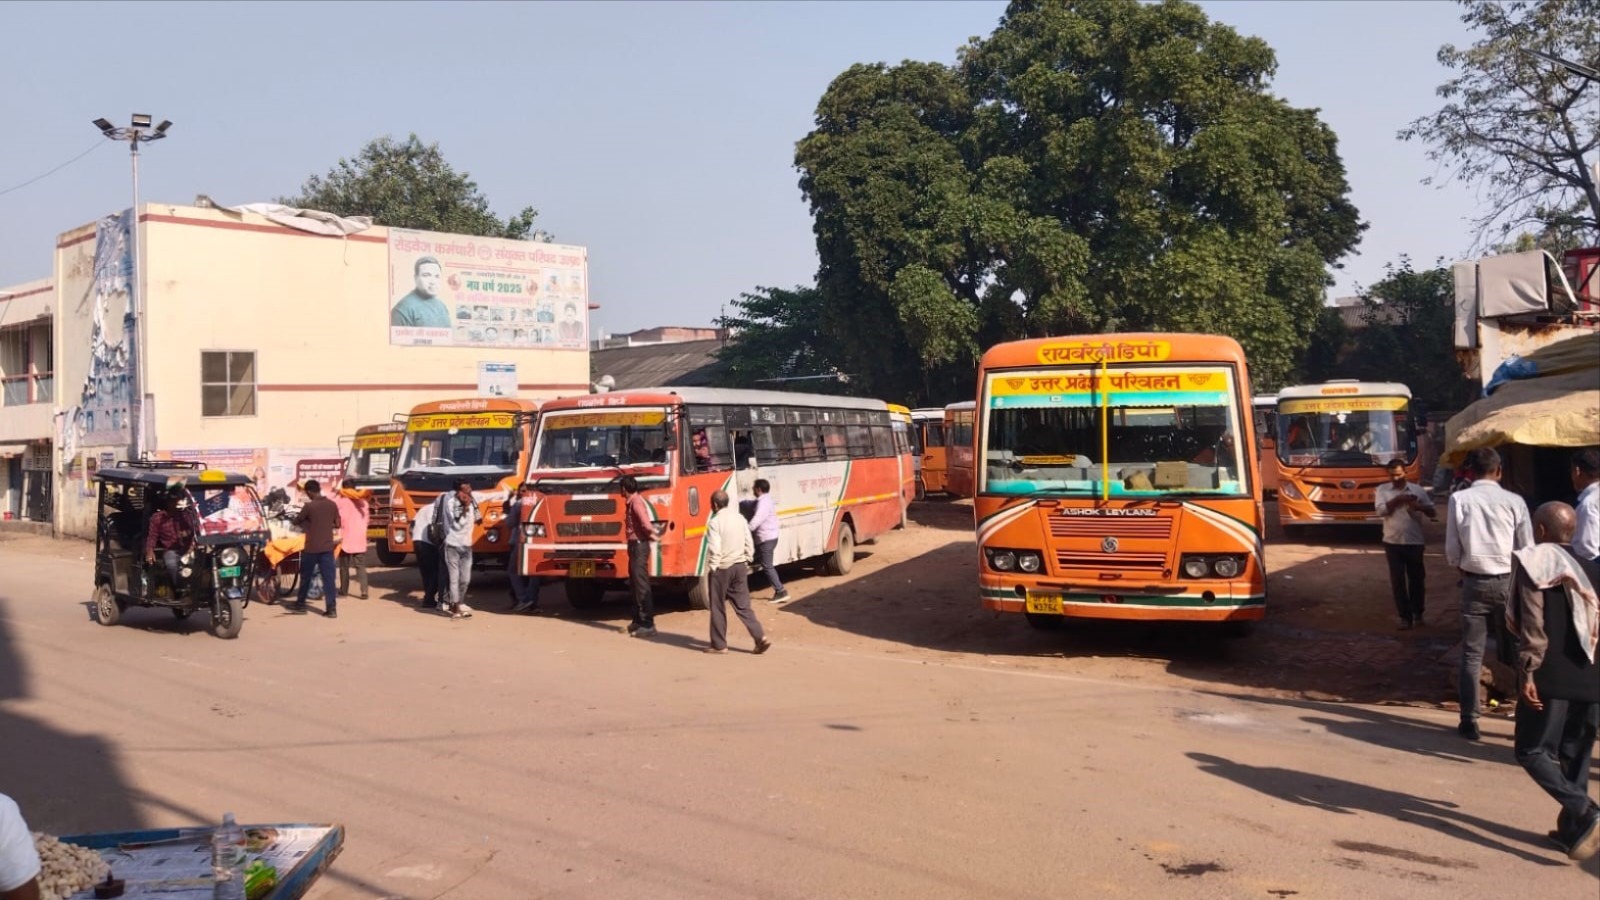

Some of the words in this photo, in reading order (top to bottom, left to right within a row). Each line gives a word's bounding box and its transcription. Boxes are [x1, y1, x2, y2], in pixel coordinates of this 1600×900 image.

[394, 238, 431, 253] रोडवेज
[466, 280, 480, 291] नव
[482, 279, 495, 292] वर्ष
[497, 282, 522, 293] 2025
[1029, 377, 1064, 392] उत्तर
[1065, 373, 1100, 391] प्रदेश
[1109, 372, 1181, 391] परिवहन
[430, 418, 448, 428] उत्तर
[1062, 508, 1100, 516] ASHOK
[1105, 508, 1157, 516] LEYLAND
